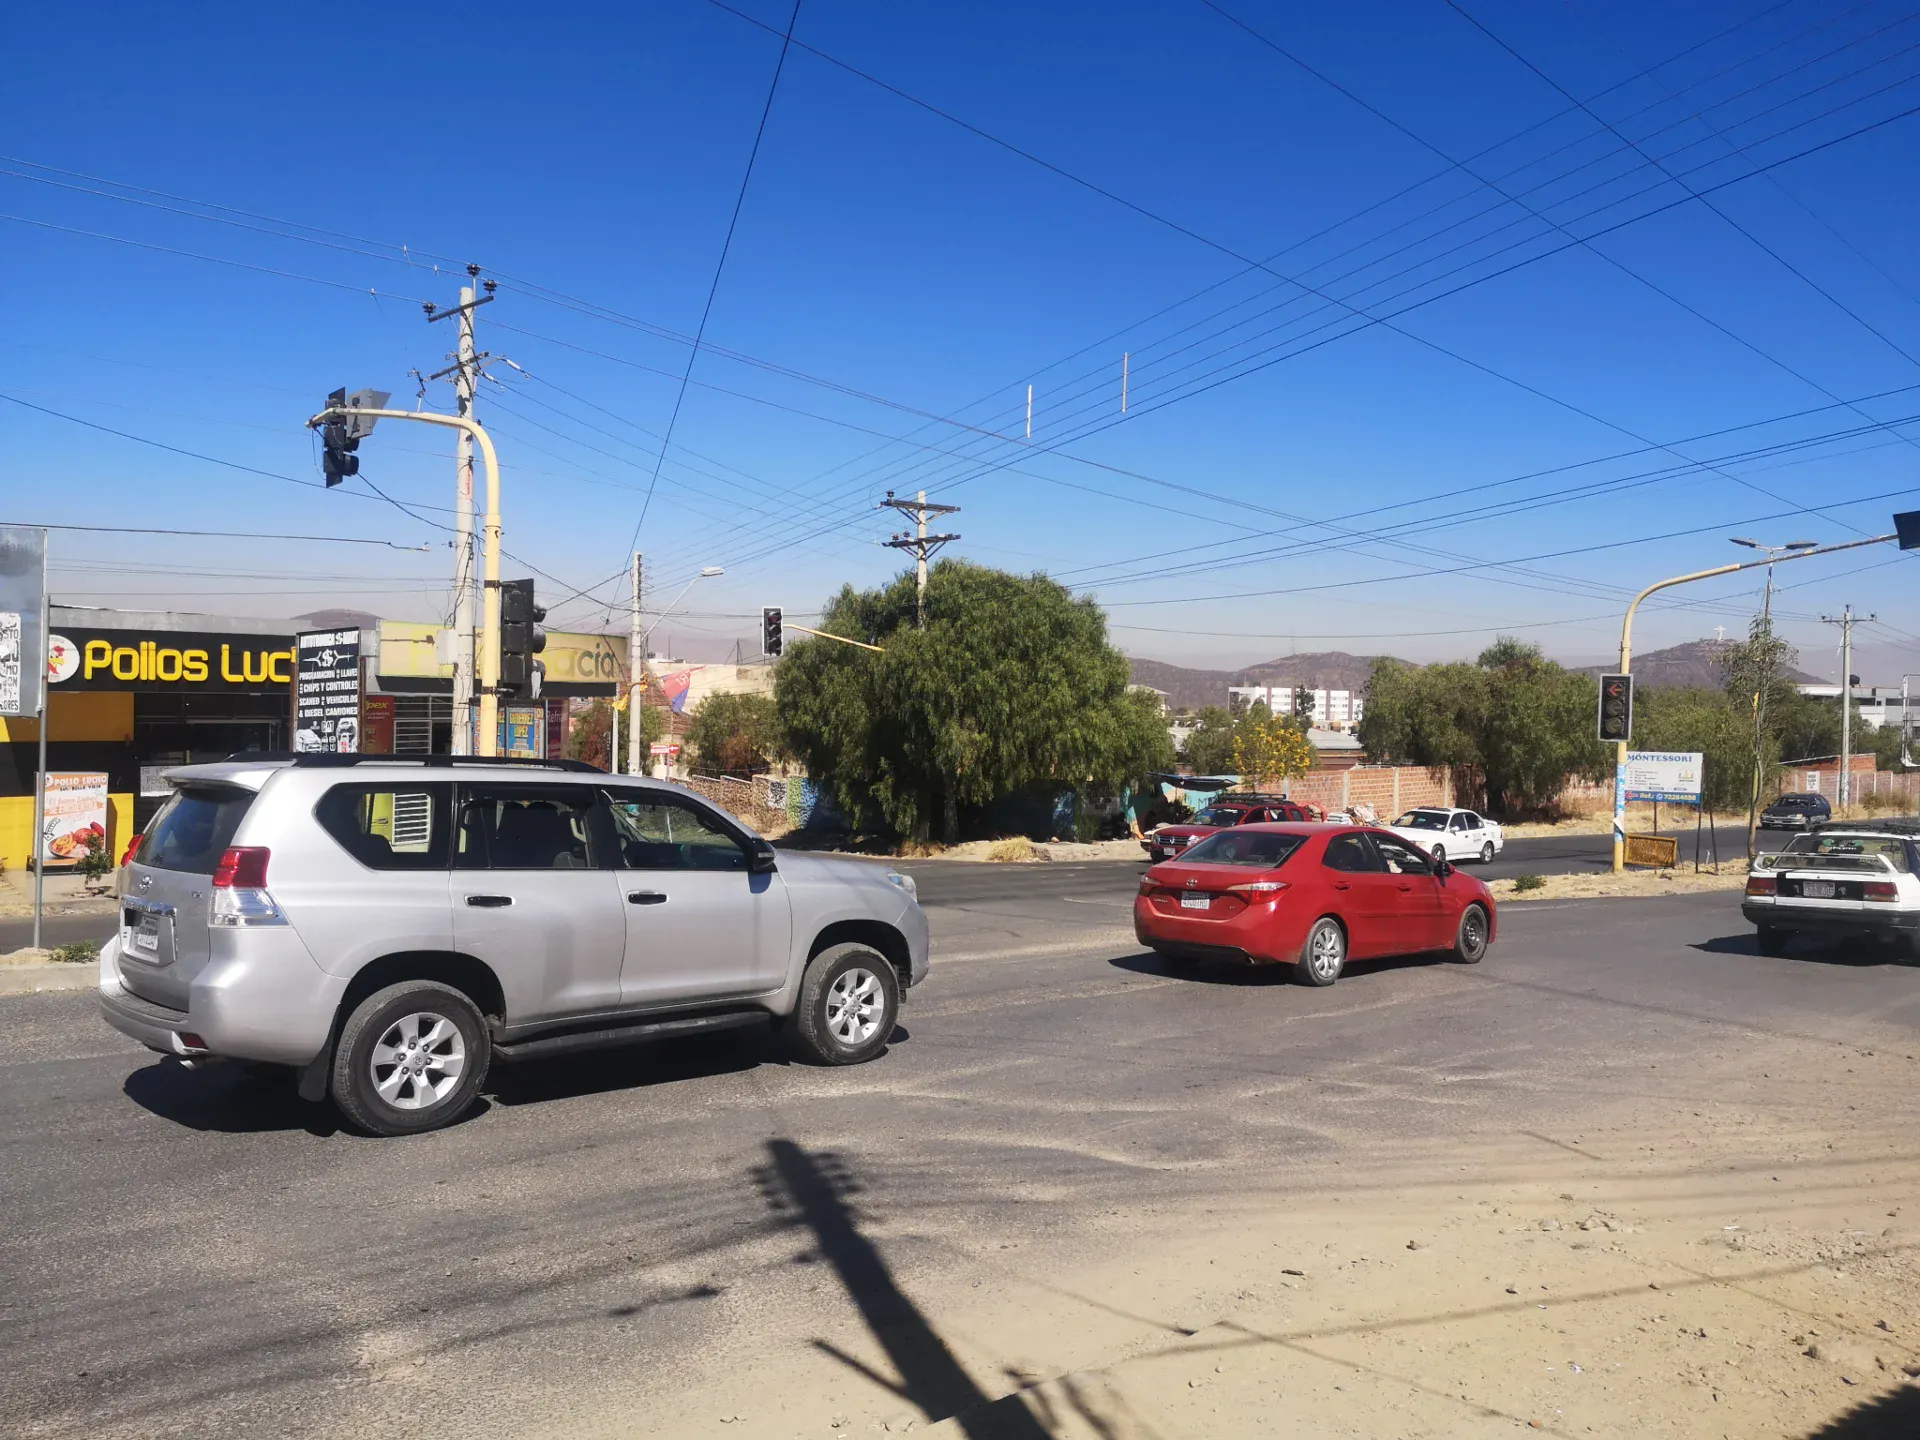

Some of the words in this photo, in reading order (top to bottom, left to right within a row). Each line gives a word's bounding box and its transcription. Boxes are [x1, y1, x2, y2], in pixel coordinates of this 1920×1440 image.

[84, 639, 209, 682] Pollos
[325, 680, 358, 691] CONTROLES
[326, 694, 358, 704] VEHICULOS
[304, 708, 323, 717] DIESEL
[325, 706, 358, 716] CAMIONES
[1627, 754, 1692, 763] MONTESSORI
[55, 777, 79, 786] POLLO
[82, 775, 107, 785] LUCHO
